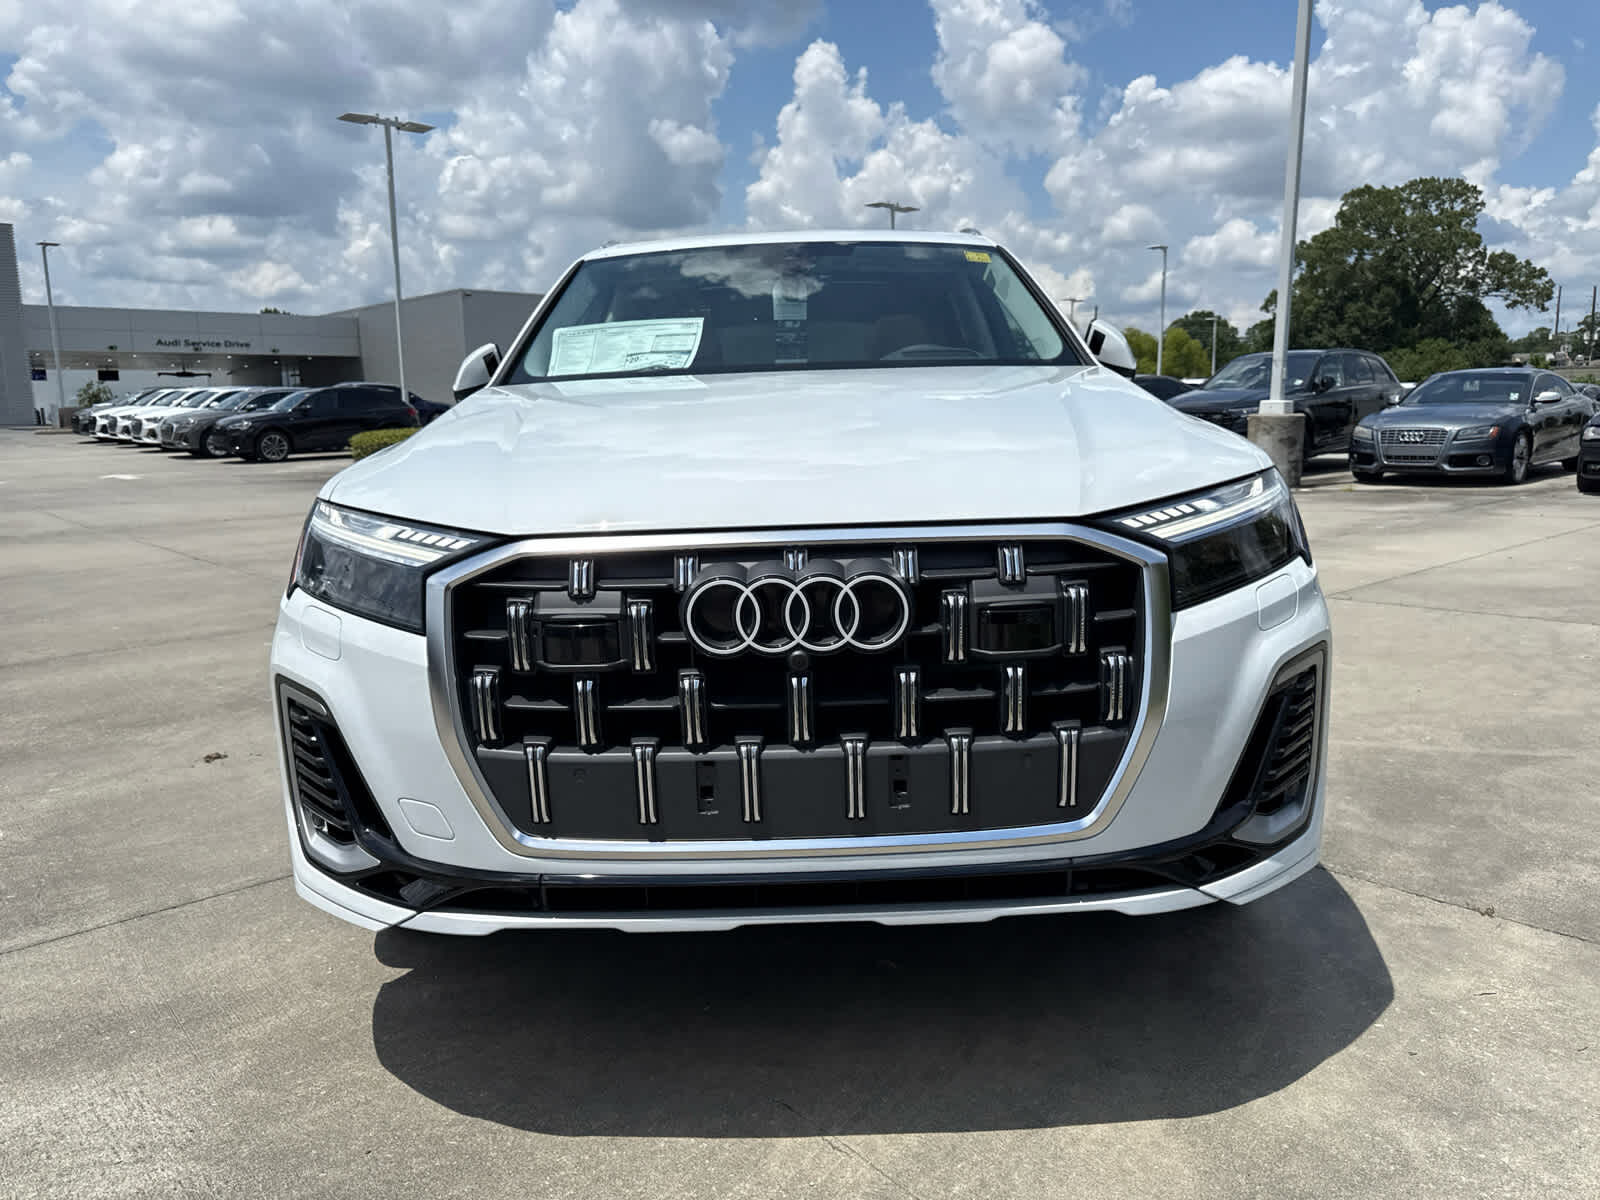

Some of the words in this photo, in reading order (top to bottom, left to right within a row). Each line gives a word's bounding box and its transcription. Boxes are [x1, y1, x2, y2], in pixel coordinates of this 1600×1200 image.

[156, 338, 181, 347] Audi
[184, 339, 221, 348] Service
[224, 340, 251, 348] Drive
